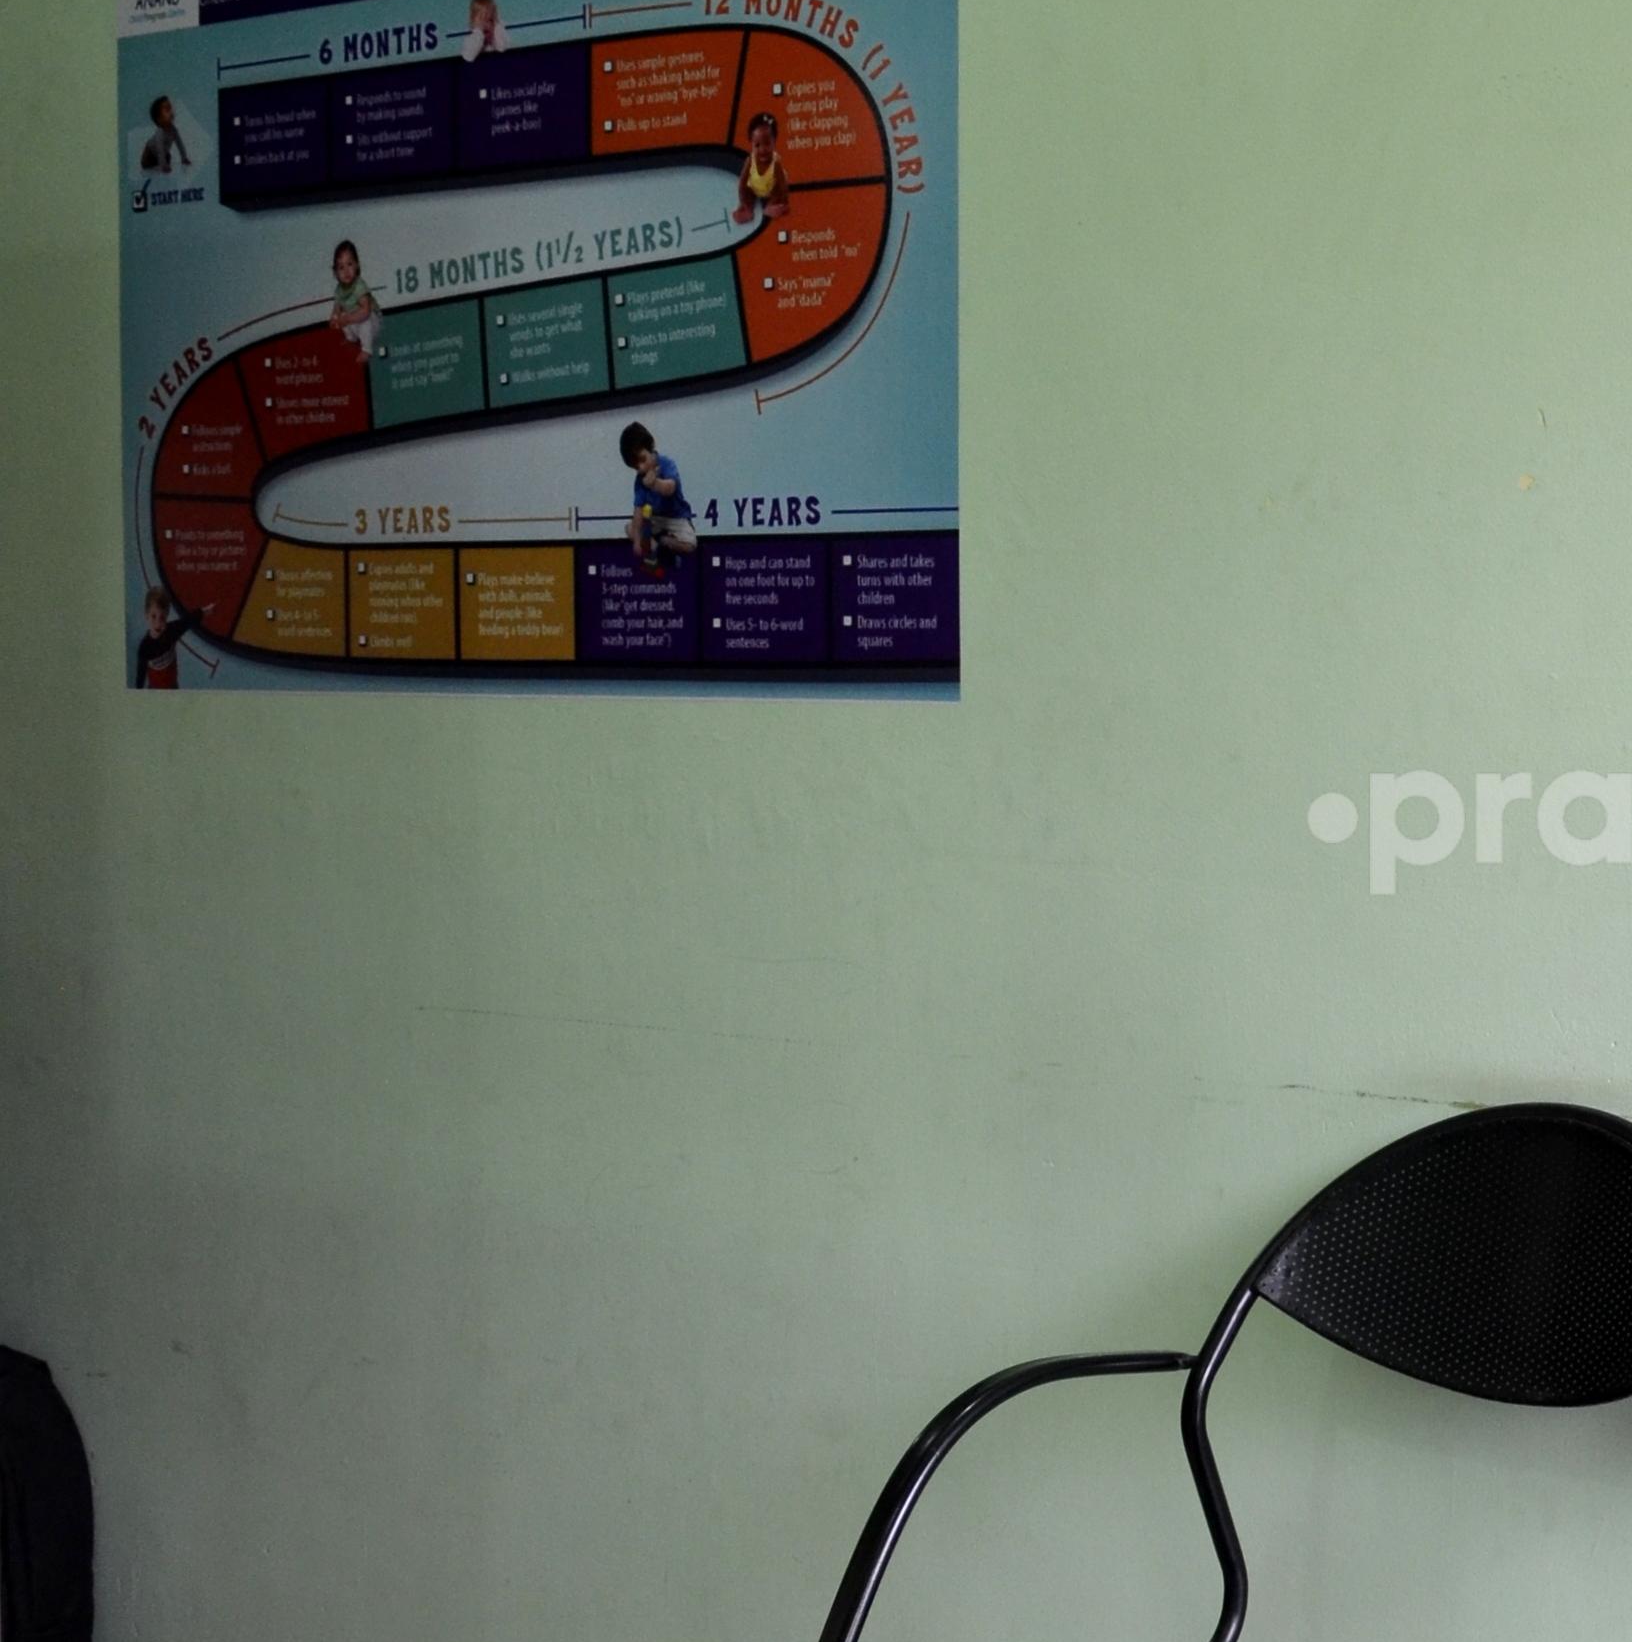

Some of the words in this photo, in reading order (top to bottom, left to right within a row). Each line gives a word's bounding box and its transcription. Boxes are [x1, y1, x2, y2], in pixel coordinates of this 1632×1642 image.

[319, 38, 334, 65] 6
[344, 22, 438, 63] MONTHS
[862, 43, 891, 81] (1
[882, 82, 925, 194] YEAR)
[151, 190, 179, 207] START
[181, 187, 205, 205] HERE
[395, 265, 419, 295] 18
[430, 246, 525, 290] MONTHS
[593, 216, 684, 262] YEARS)
[777, 275, 799, 292] Says
[777, 294, 796, 309] and
[138, 415, 157, 440] 2
[149, 336, 215, 411] YEARS
[355, 508, 368, 535] 3
[378, 506, 451, 535] YEARS
[704, 498, 719, 527] 4
[734, 495, 822, 528] YEARS
[857, 554, 889, 570] Shares
[890, 555, 907, 568] and
[909, 554, 935, 569] takes
[857, 574, 882, 588] turns
[884, 573, 905, 588] with
[907, 573, 933, 587] other
[857, 591, 896, 606] children
[857, 615, 886, 630] Draws
[888, 615, 918, 630] circles
[920, 615, 938, 629] and
[857, 634, 893, 651] squares
